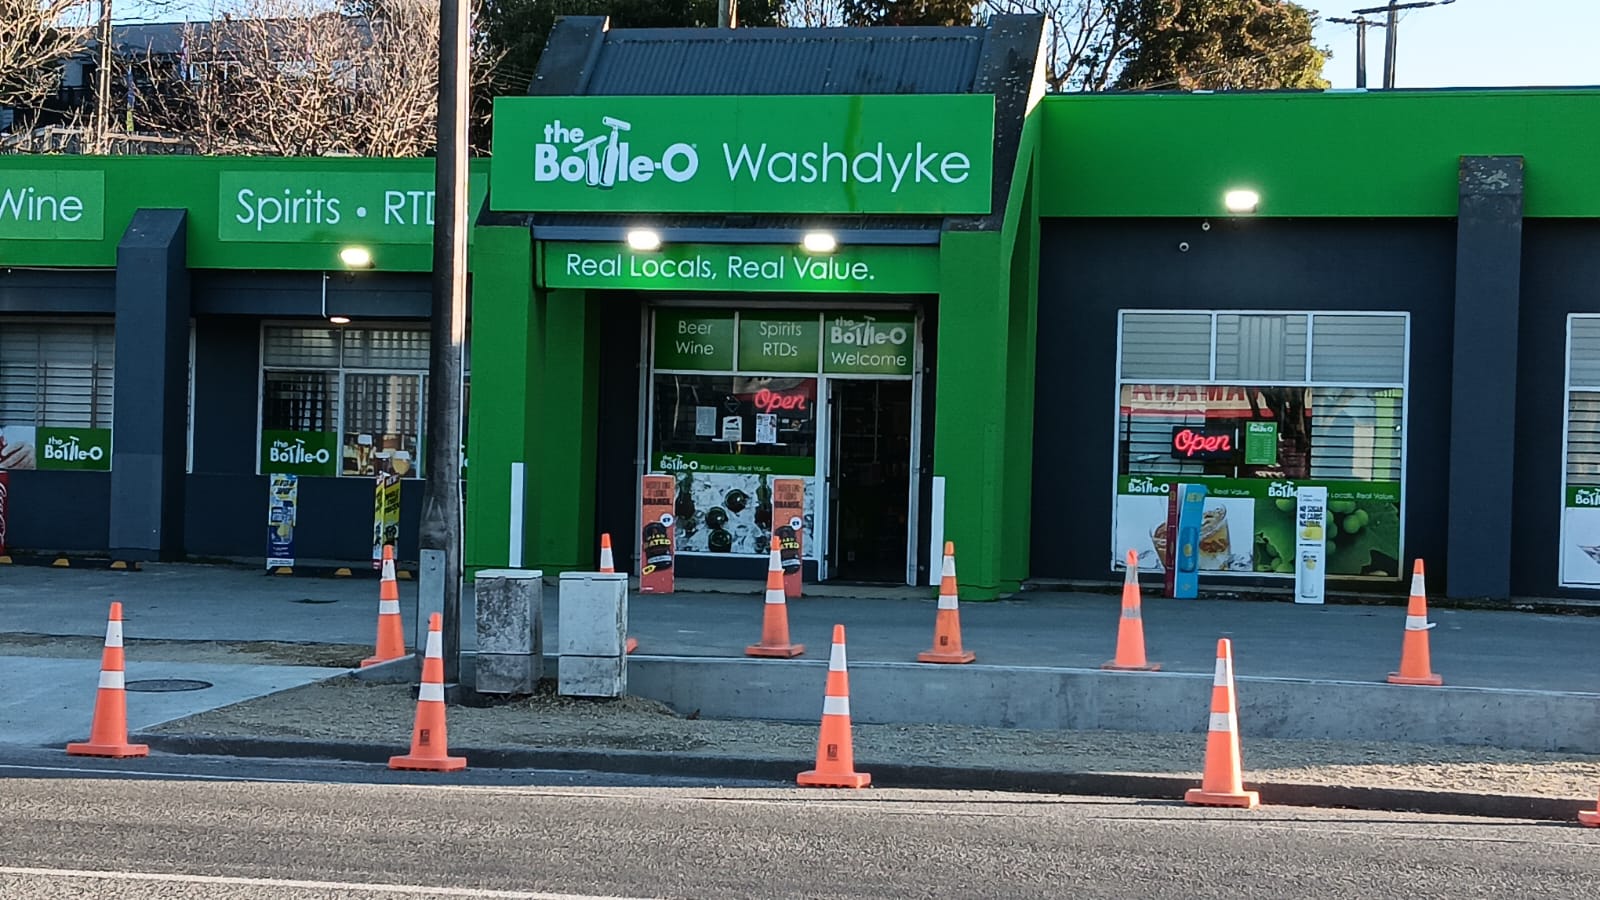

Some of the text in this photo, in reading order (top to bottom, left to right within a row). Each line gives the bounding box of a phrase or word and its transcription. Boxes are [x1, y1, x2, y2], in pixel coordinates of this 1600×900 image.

[543, 119, 585, 144] the
[722, 141, 971, 193] Washdyke
[0, 186, 83, 222] Wine
[236, 188, 340, 232] Spirits
[567, 253, 875, 280] Real Locals, Real Value.
[678, 320, 712, 335] Beer
[759, 321, 802, 339] Spirits
[675, 340, 714, 356] Wine
[762, 342, 798, 357] RTDs
[831, 351, 907, 366] Welcome
[754, 388, 806, 412] Open
[1174, 429, 1231, 457] Open
